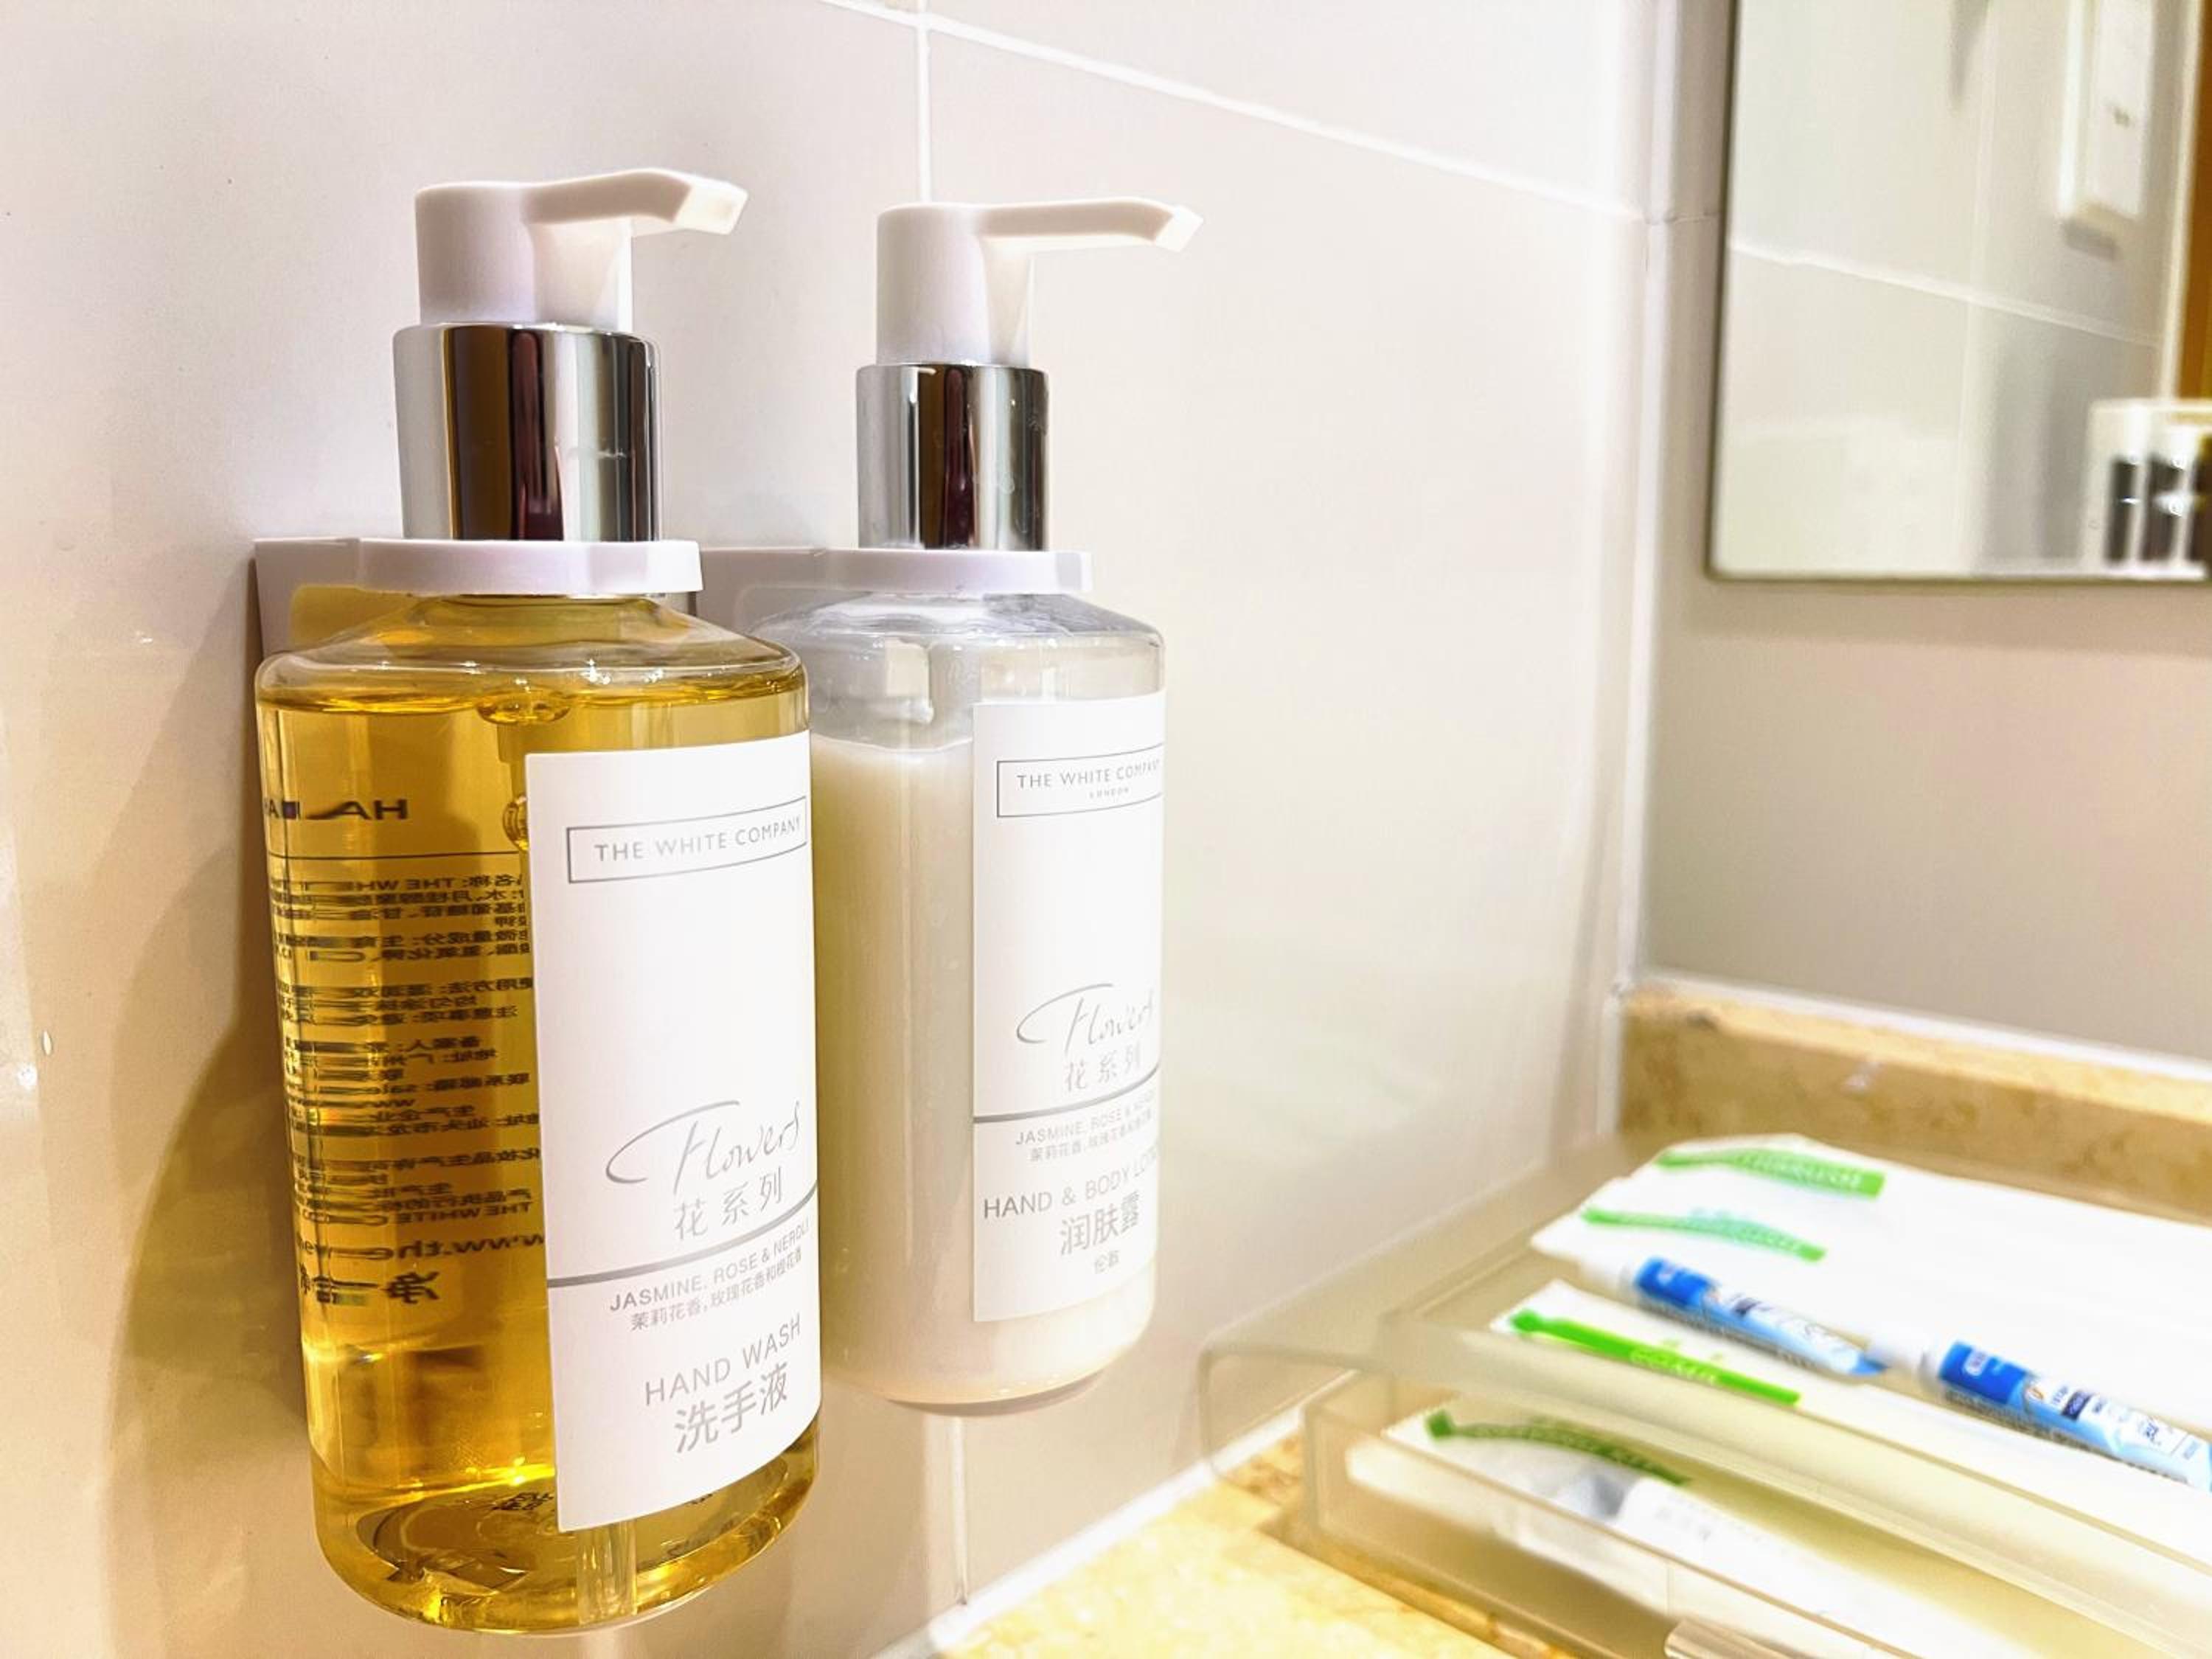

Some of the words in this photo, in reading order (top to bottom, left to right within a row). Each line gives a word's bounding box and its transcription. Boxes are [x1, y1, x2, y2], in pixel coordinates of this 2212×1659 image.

[1017, 774, 1052, 789] THE
[1060, 768, 1110, 785] WHITE
[594, 841, 644, 861] THE
[655, 832, 727, 857] WHITE
[734, 814, 801, 846] COMPANY
[605, 1100, 801, 1194] Flowers
[673, 1166, 783, 1240] 花系列
[984, 1192, 1053, 1219] HAND
[1062, 1186, 1077, 1206] &
[1085, 1167, 1130, 1201] BODY
[1059, 1190, 1139, 1256] 润肤露
[714, 1252, 758, 1284] ROSE
[762, 1247, 770, 1263] &
[774, 1217, 810, 1256] NEROLI
[644, 1358, 732, 1406] HAND
[742, 1312, 802, 1369] WASH
[674, 1361, 790, 1454] 洗手液
